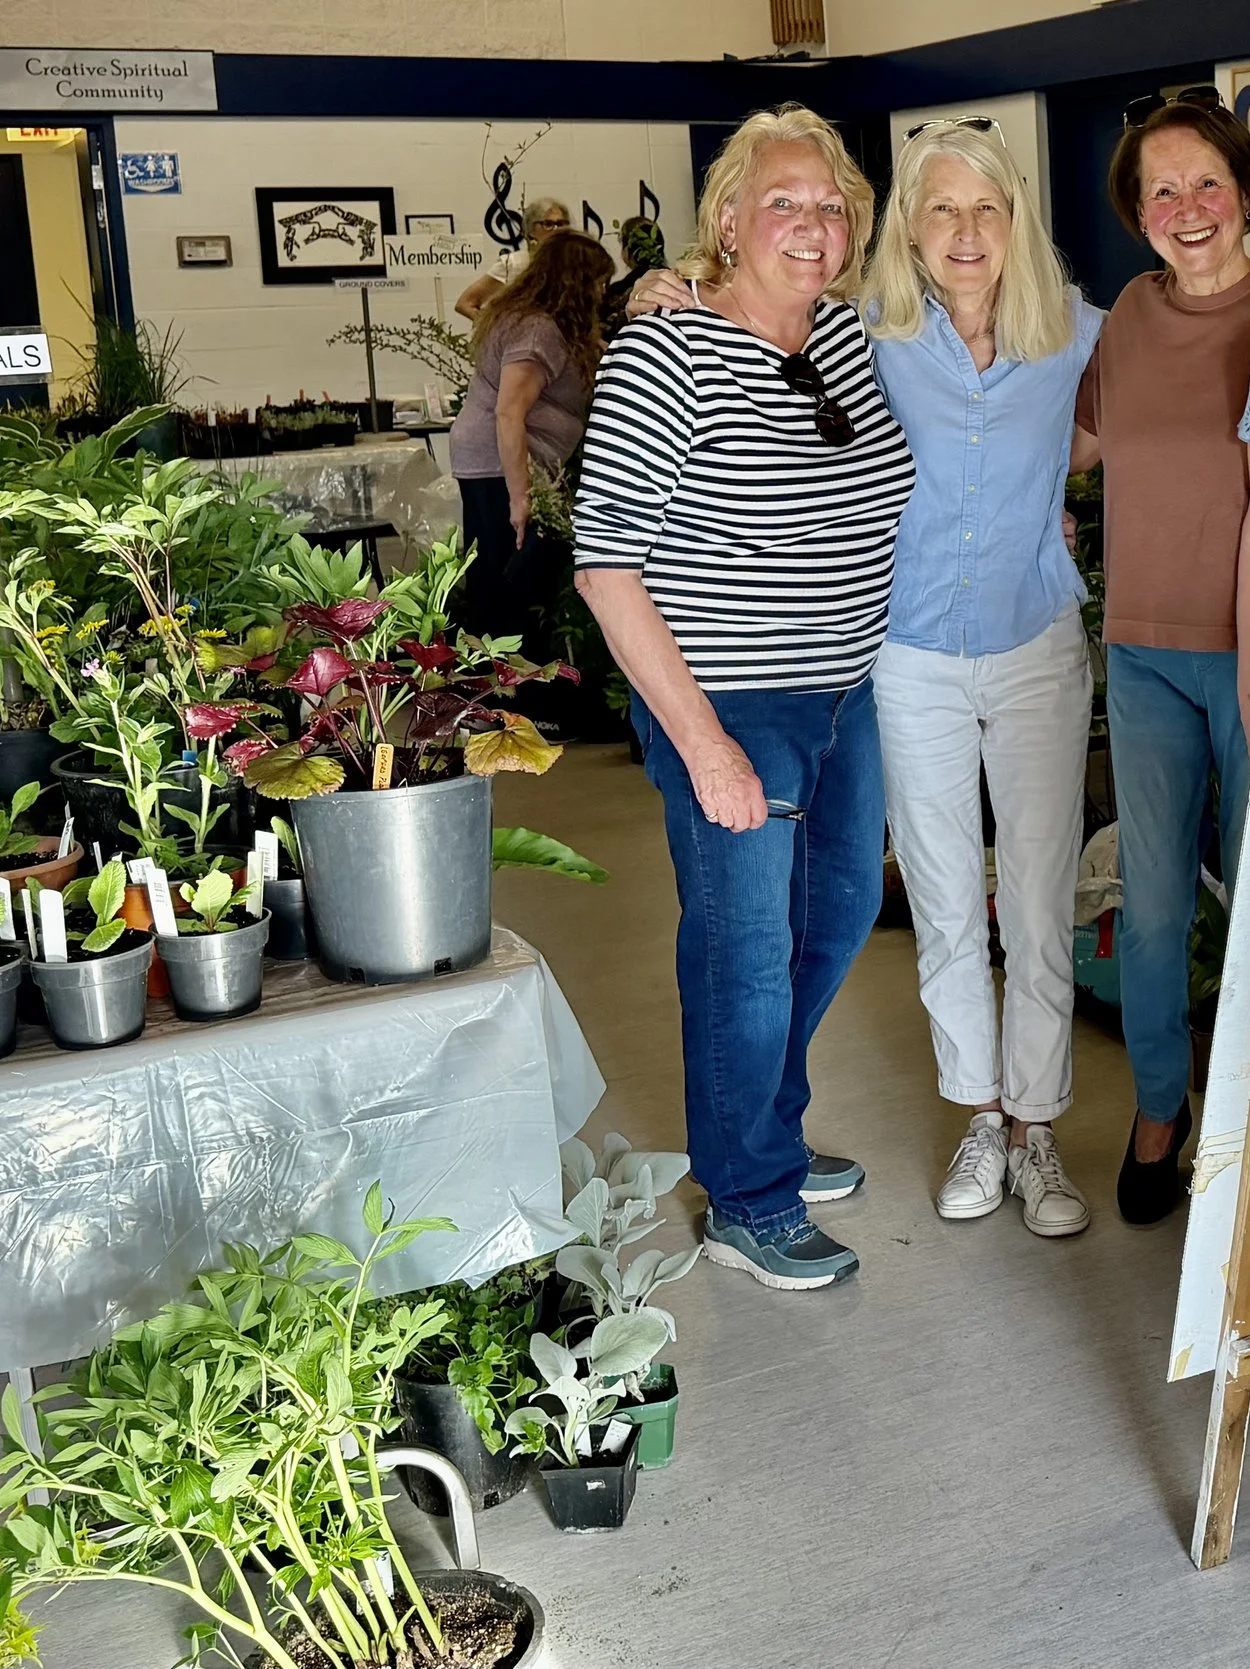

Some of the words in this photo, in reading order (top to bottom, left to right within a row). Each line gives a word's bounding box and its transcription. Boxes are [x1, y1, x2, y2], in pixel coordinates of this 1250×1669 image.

[25, 58, 107, 77] Creative
[110, 59, 188, 80] Spiritual
[56, 80, 164, 102] Community
[386, 243, 483, 270] Membership
[339, 280, 373, 288] GROUND
[374, 279, 406, 288] COVERS
